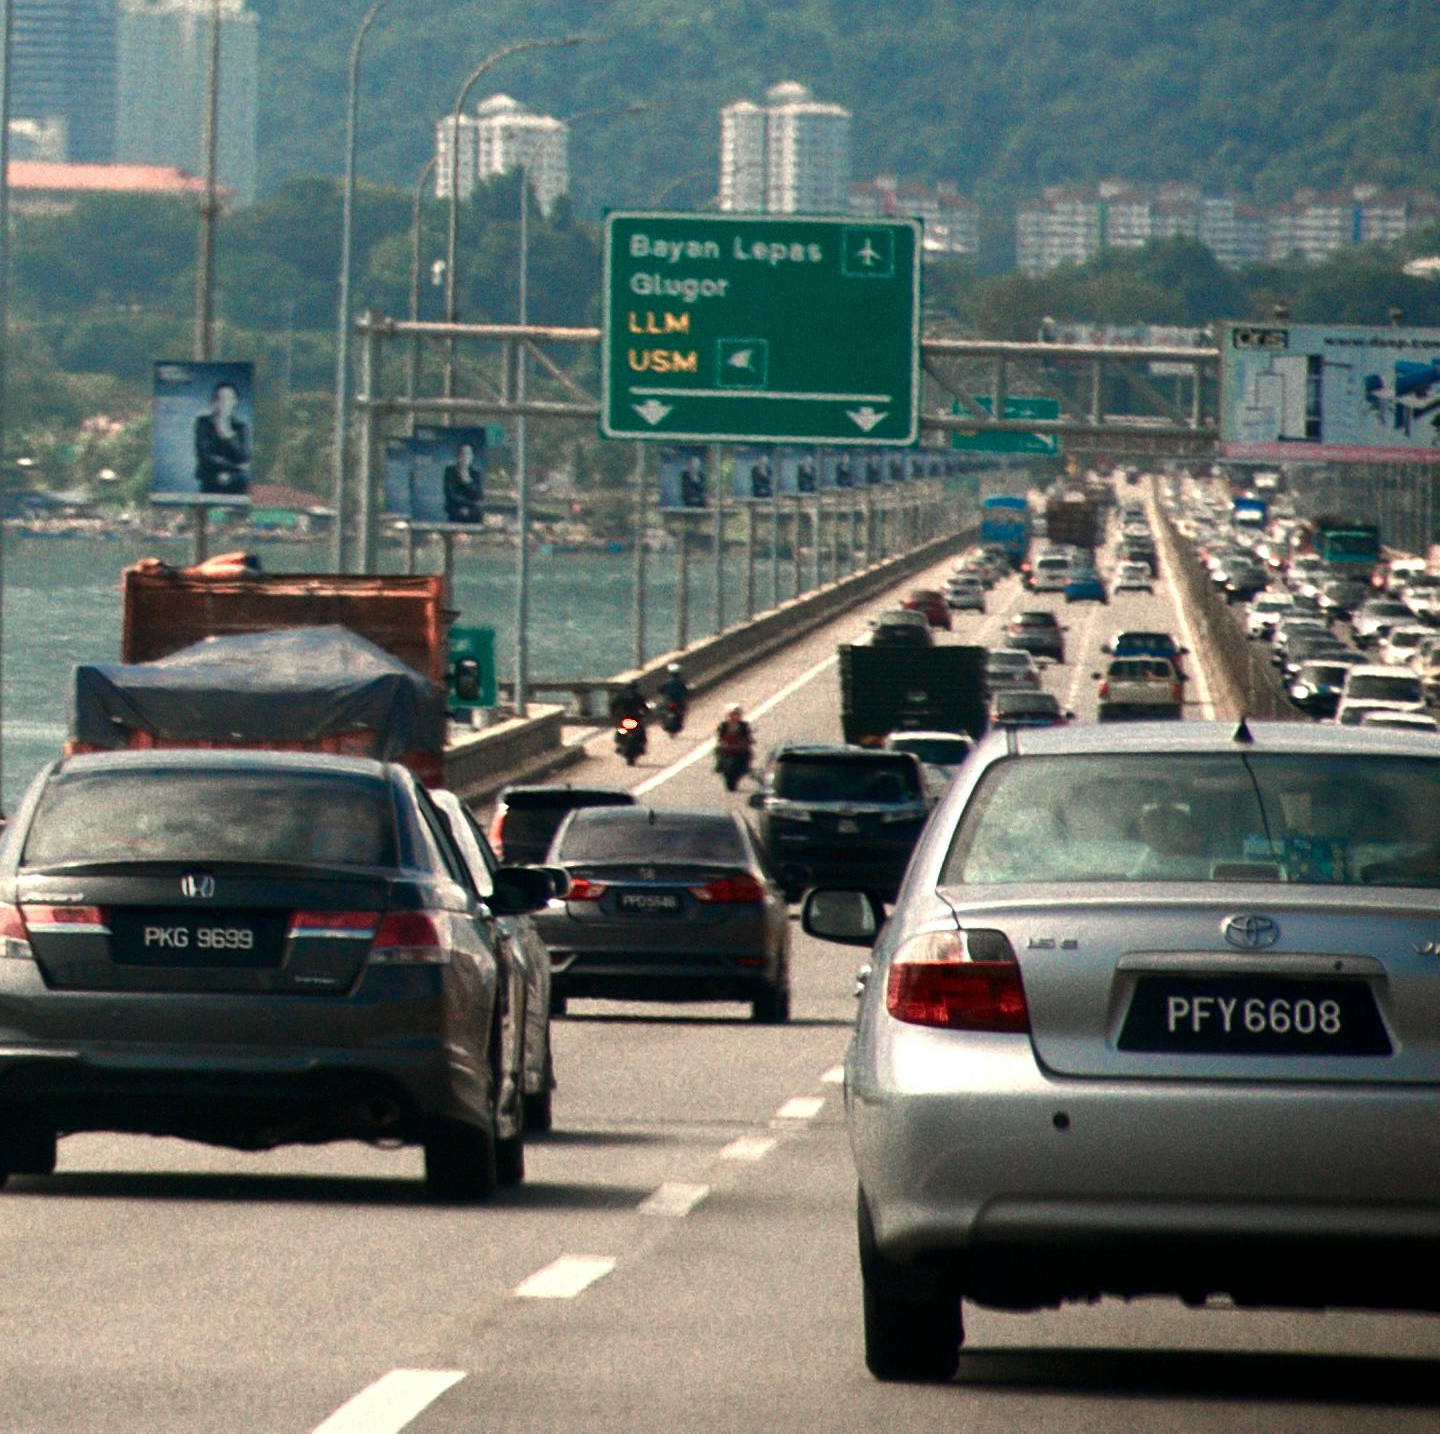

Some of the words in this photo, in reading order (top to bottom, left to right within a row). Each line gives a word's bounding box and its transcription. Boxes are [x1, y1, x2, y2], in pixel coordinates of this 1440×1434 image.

[629, 234, 720, 263] Bayan
[733, 236, 822, 265] Lepas
[630, 273, 729, 302] Glugor
[628, 311, 690, 334] LLM
[628, 349, 698, 372] USM
[144, 926, 190, 948] PKG
[196, 928, 254, 950] 9699
[1167, 996, 1342, 1035] PFY6608
